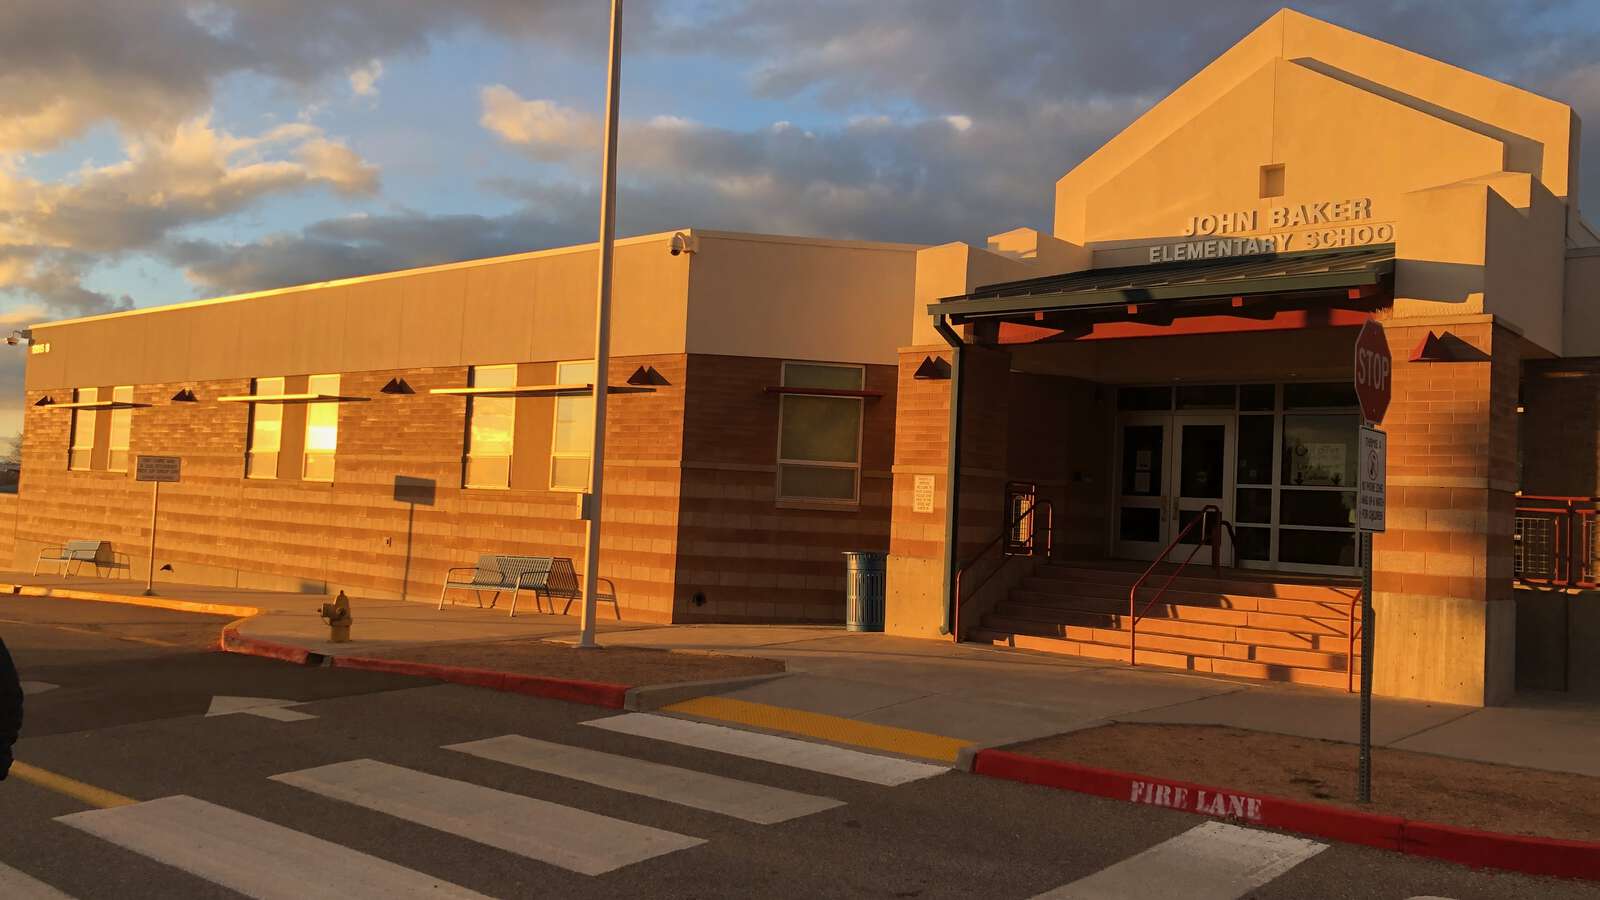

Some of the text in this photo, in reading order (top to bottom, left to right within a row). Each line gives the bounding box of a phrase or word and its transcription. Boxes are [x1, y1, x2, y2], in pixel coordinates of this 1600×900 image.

[1185, 198, 1372, 236] JOHN BAKER
[1150, 224, 1394, 263] ELEMENTARY SCHOO
[1358, 347, 1389, 391] STOP
[1131, 780, 1263, 820] FIRE LANE
